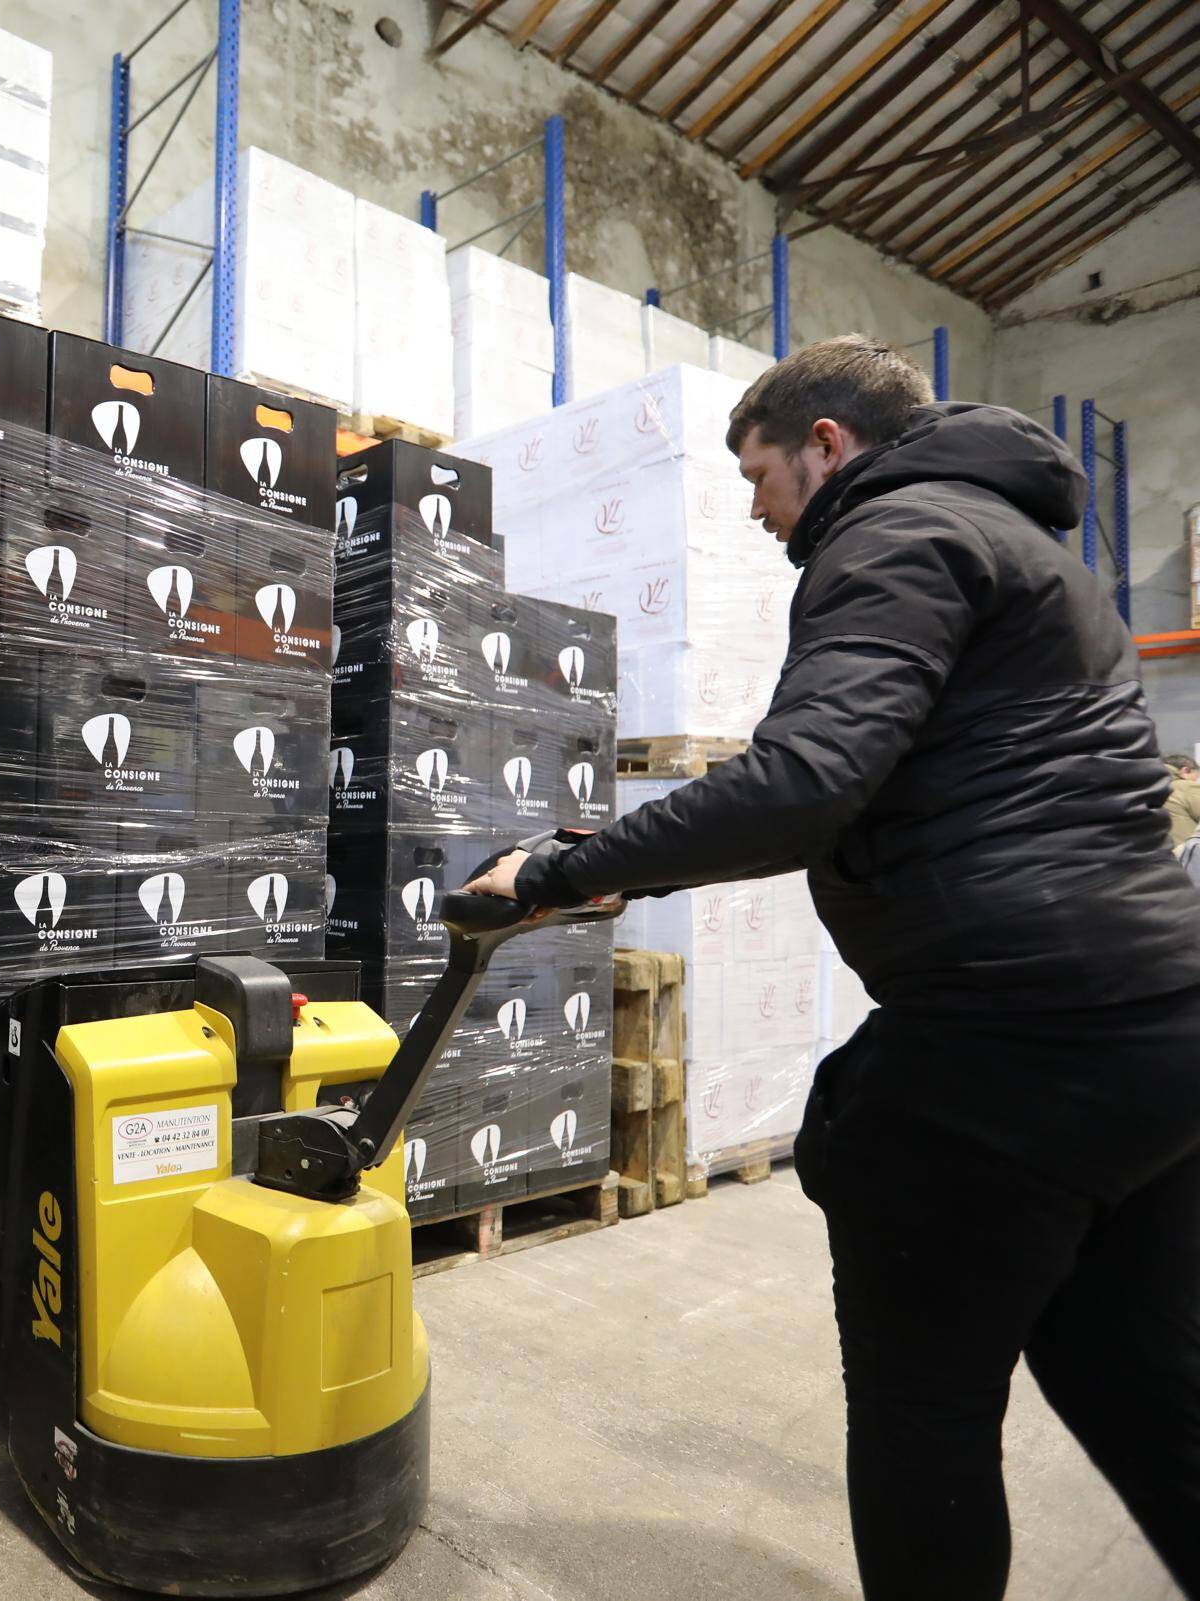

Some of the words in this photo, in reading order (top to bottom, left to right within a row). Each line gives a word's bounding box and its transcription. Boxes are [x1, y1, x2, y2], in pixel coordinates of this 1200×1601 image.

[114, 455, 168, 474] CONSIGNE
[259, 487, 306, 506] CONSIGNE
[48, 602, 107, 619] CONSIGNE
[168, 618, 220, 634] CONSIGNE
[273, 634, 319, 648] CONSIGNE
[332, 663, 363, 674] NSIGNE
[104, 769, 160, 781] CONSIGNE
[252, 778, 299, 789] CONSIGNE
[335, 791, 377, 800] CONSIGNE
[265, 923, 312, 934] CONSIGNE
[416, 922, 448, 932] CONSIG
[38, 929, 97, 941] CONSIGNE
[157, 1115, 210, 1128] MANUTENTION
[125, 1122, 147, 1136] G2A
[162, 1134, 171, 1142] 04
[172, 1132, 181, 1141] 42
[201, 1128, 210, 1137] 00
[117, 1151, 136, 1160] VENTE
[140, 1146, 171, 1157] LOCATION
[176, 1140, 214, 1151] MAINTENANCE
[155, 1162, 177, 1174] Yale
[407, 1178, 446, 1193] CONSIGNE
[32, 1191, 62, 1348] Yale
